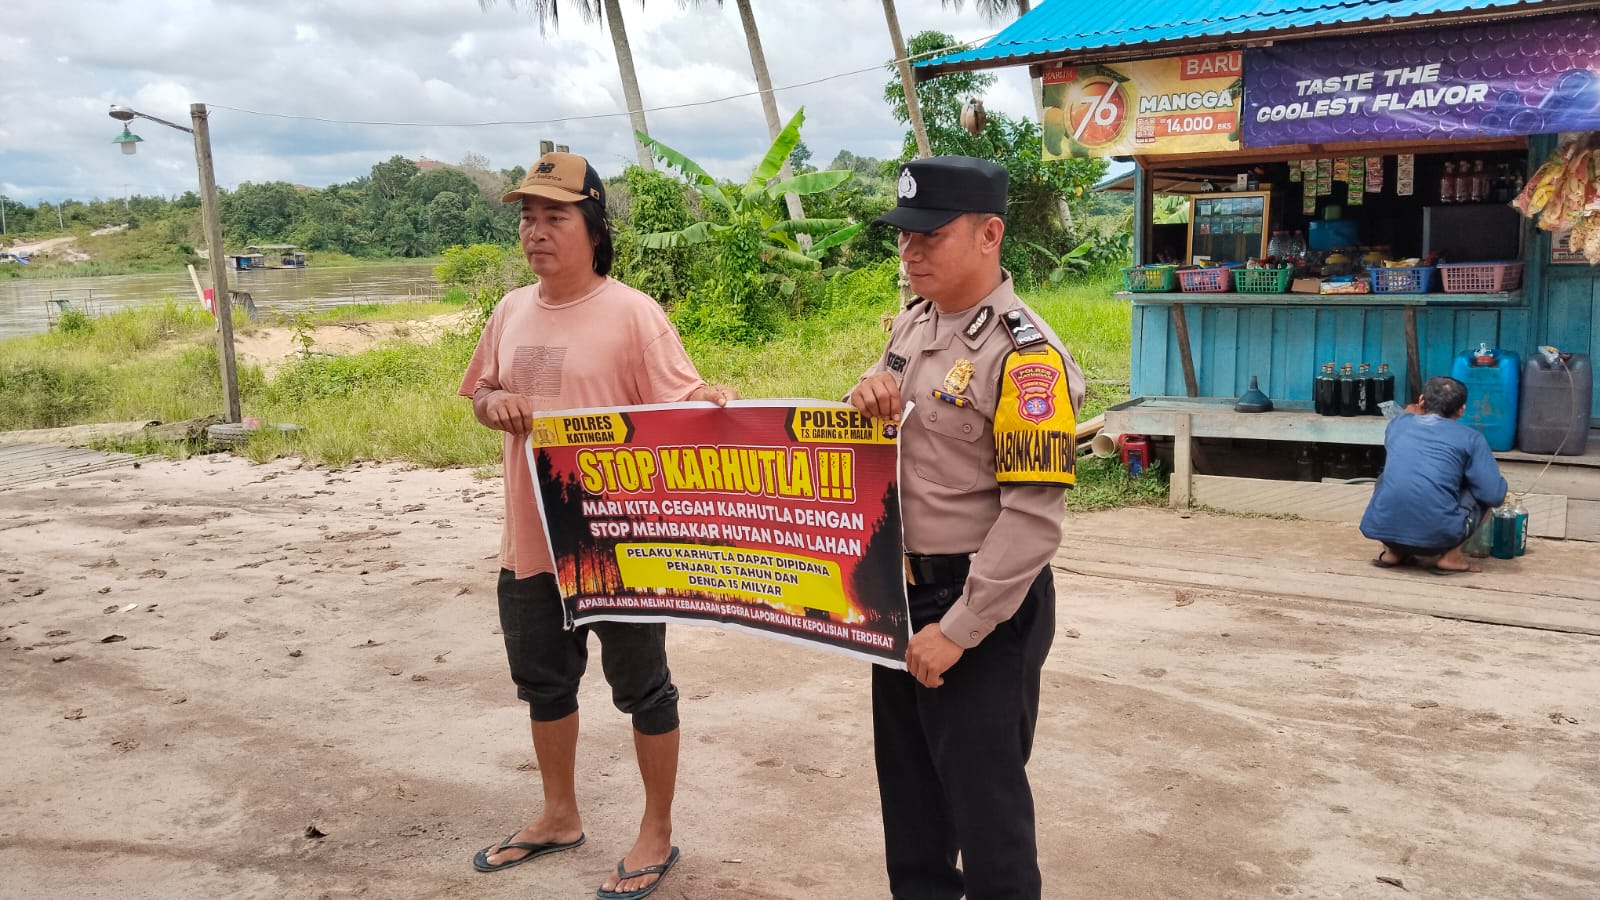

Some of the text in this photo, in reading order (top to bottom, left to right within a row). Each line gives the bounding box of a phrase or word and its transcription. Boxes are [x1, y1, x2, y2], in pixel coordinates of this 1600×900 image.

[1186, 54, 1242, 76] BARU
[1295, 63, 1441, 97] TASTE THE
[1073, 81, 1118, 141] 76
[1140, 92, 1233, 113] MANGGA
[1256, 83, 1488, 123] COOLEST FLAVOR
[1167, 116, 1213, 133] 14.000
[563, 415, 612, 431] POLRES
[812, 429, 836, 439] GARING
[838, 430, 842, 439] &
[851, 429, 873, 440] MALAN
[566, 431, 615, 444] KATINGAN
[578, 446, 853, 500] STOP KARHUTLA !!!
[582, 500, 864, 530] MARI KITA CEGAH KARHUTLA DENGAN
[590, 522, 861, 556] STOP MEMBAKAR HUTAN DAN LAHAN
[627, 548, 830, 577] PELAKU KARHUTLA DAPAT DIPIDANA
[666, 561, 799, 585] PENJARA 15 TAHUN DAN
[688, 575, 782, 596] DENDA 15 MILYAR
[578, 598, 893, 649] APABILA ANDA MELIHAT KEBAKARAN SEGERA LAPORKAN KE KEPOLISIAN TERDEKAT
